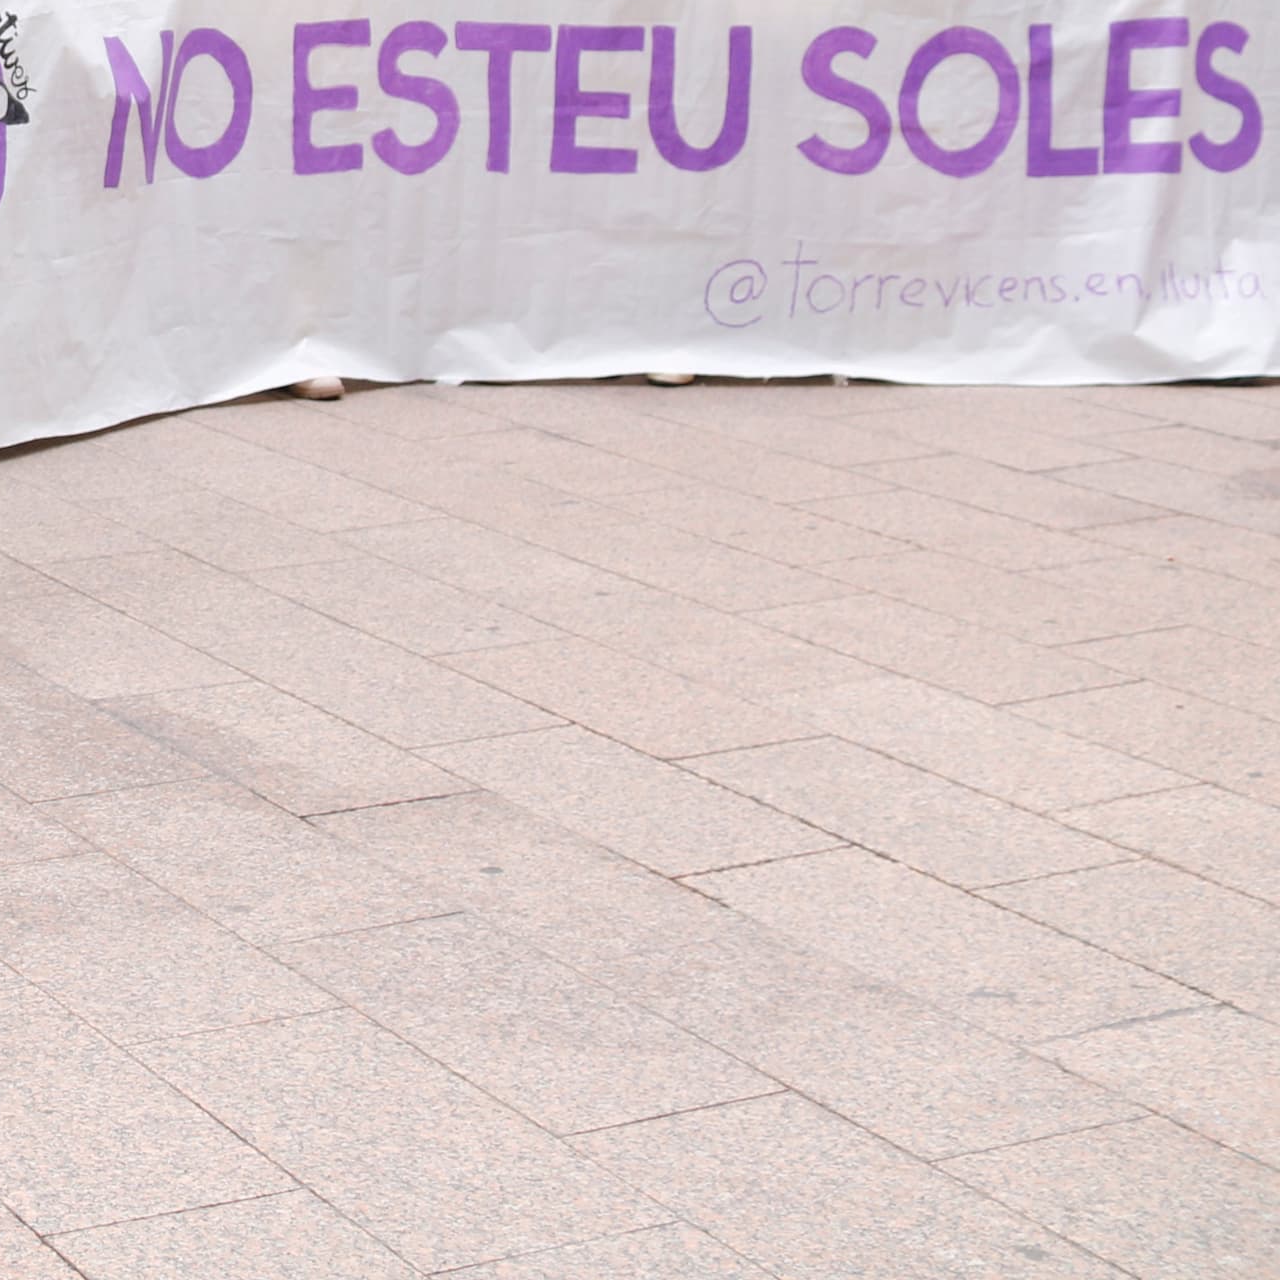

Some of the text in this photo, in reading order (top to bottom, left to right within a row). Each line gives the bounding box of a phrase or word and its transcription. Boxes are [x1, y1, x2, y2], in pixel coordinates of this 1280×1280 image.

[103, 16, 1263, 188] NO ESTEU SOLES
